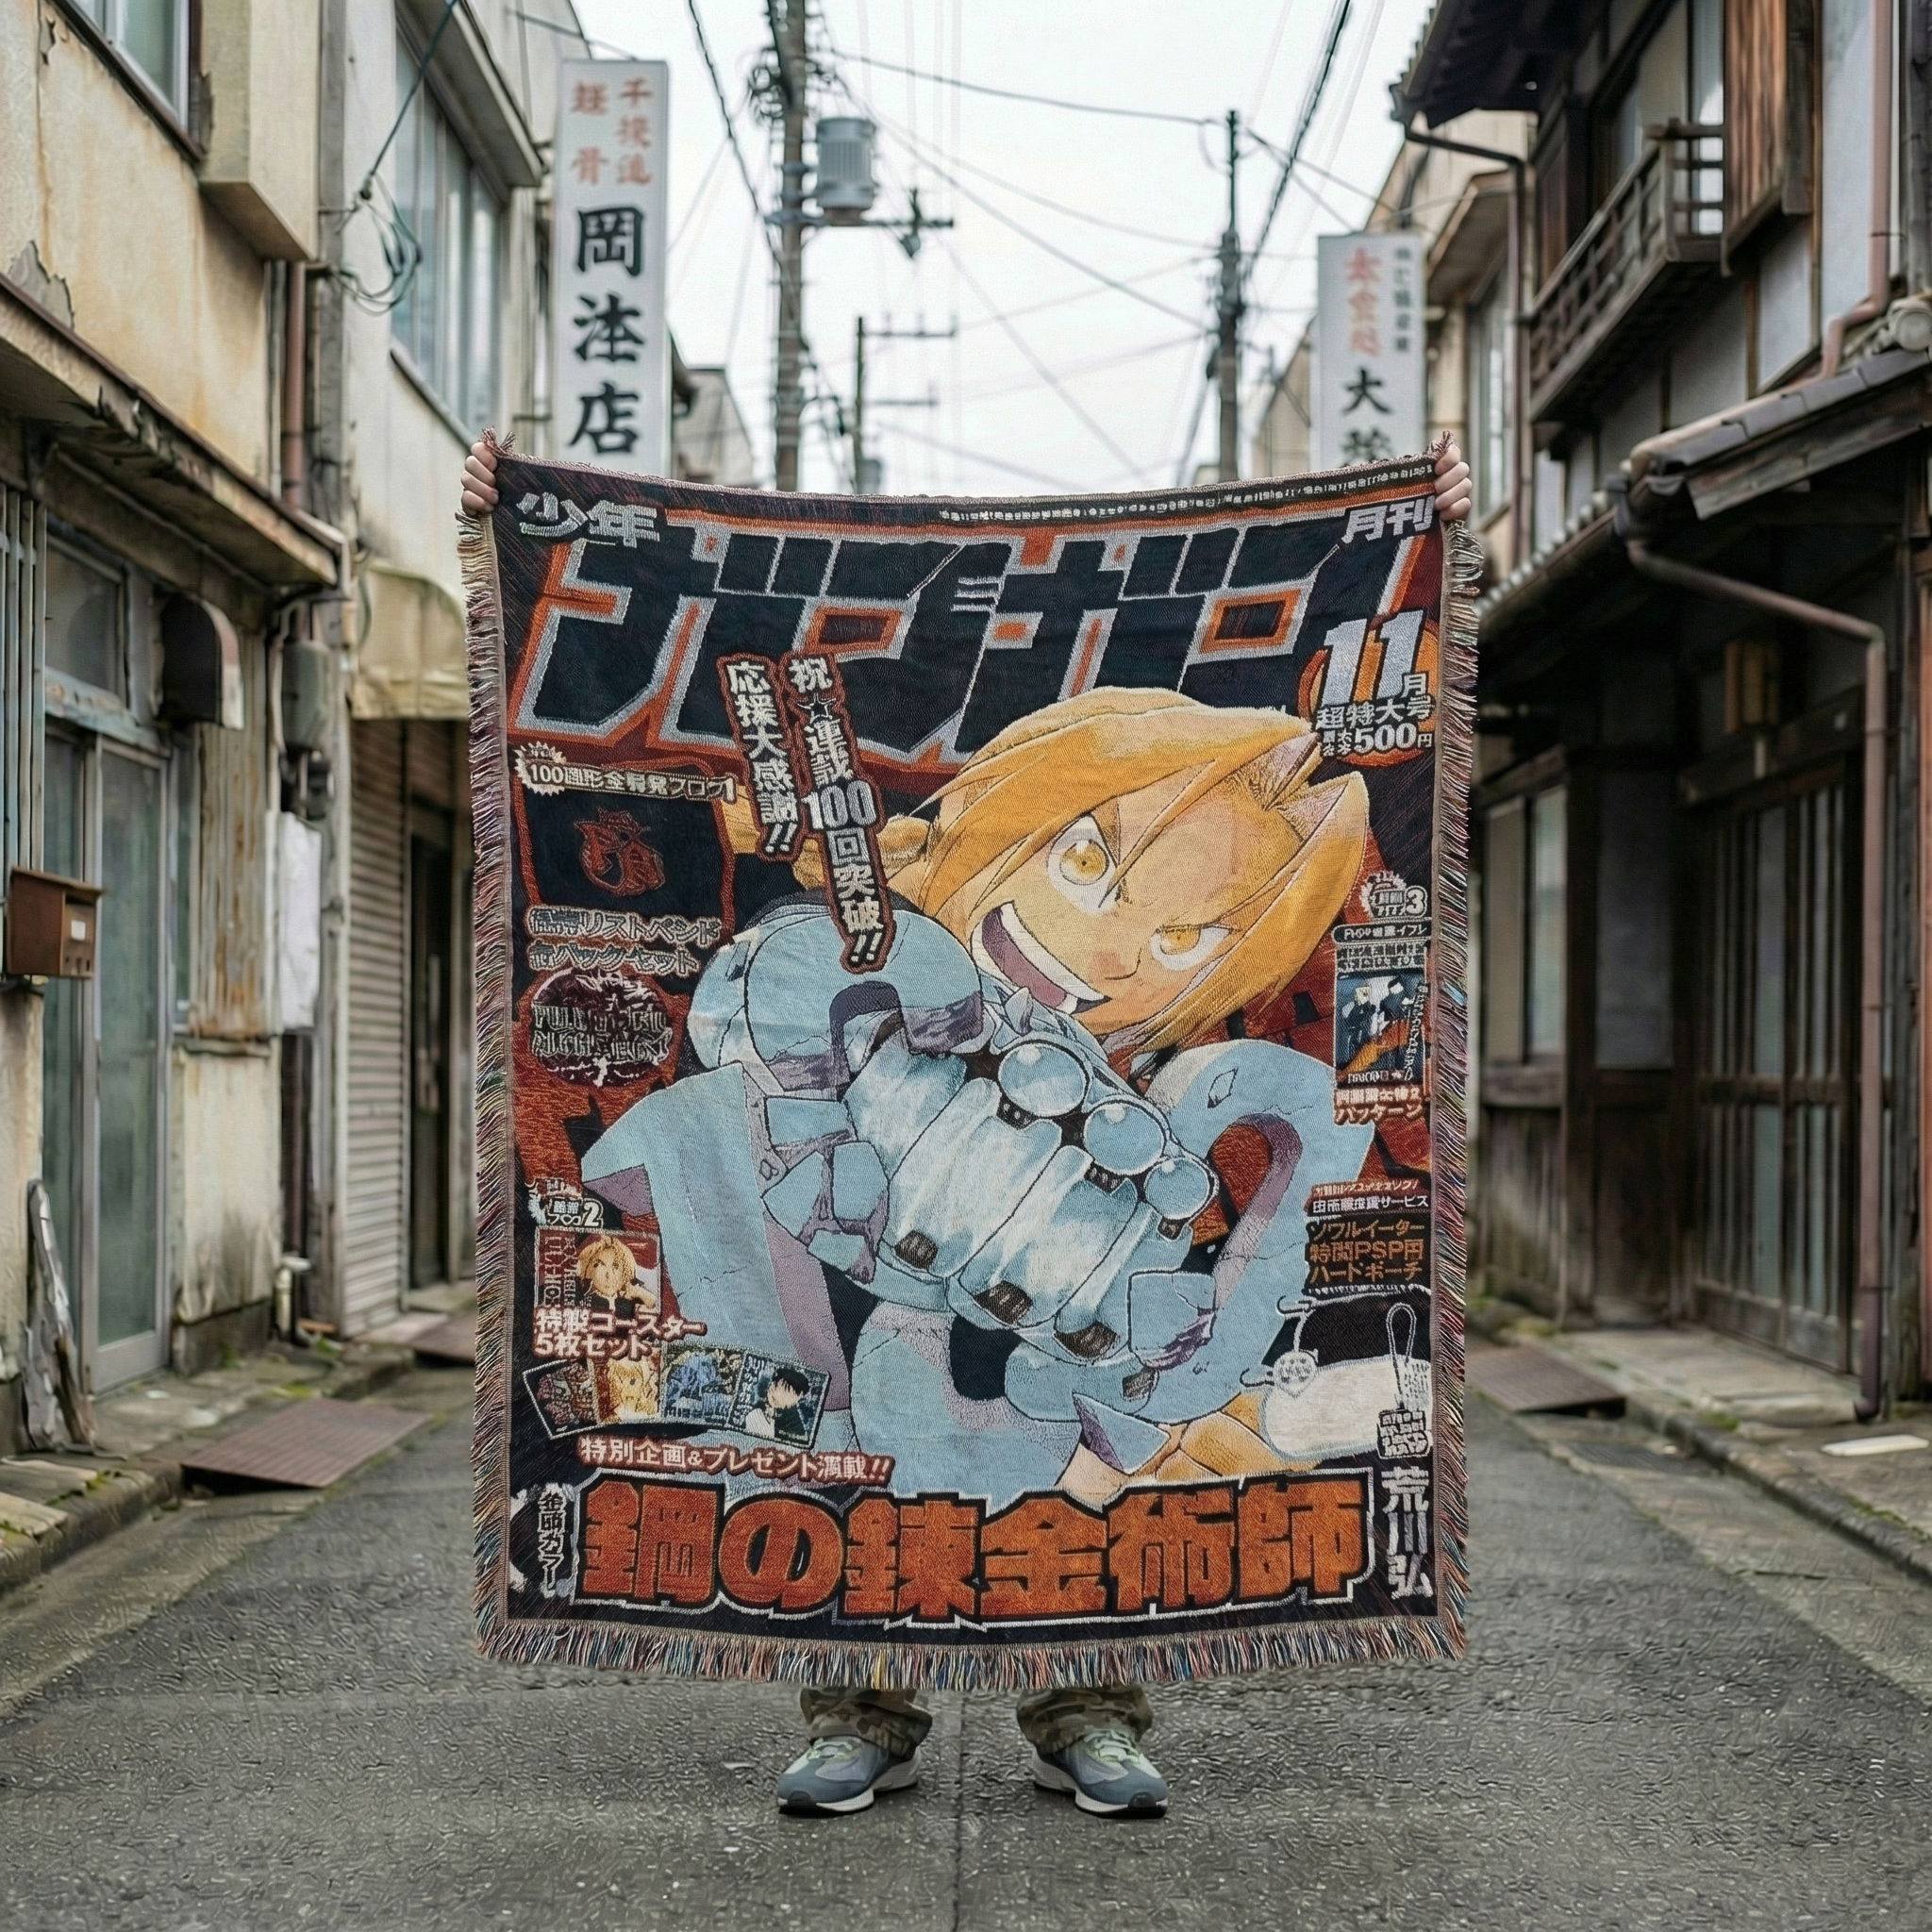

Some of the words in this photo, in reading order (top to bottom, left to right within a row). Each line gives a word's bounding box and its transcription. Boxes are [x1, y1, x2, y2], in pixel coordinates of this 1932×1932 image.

[515, 491, 660, 547] 少年
[1341, 495, 1435, 545] 月刊
[1353, 722, 1433, 754] 500円
[1381, 1465, 1434, 1601] 荒川弘
